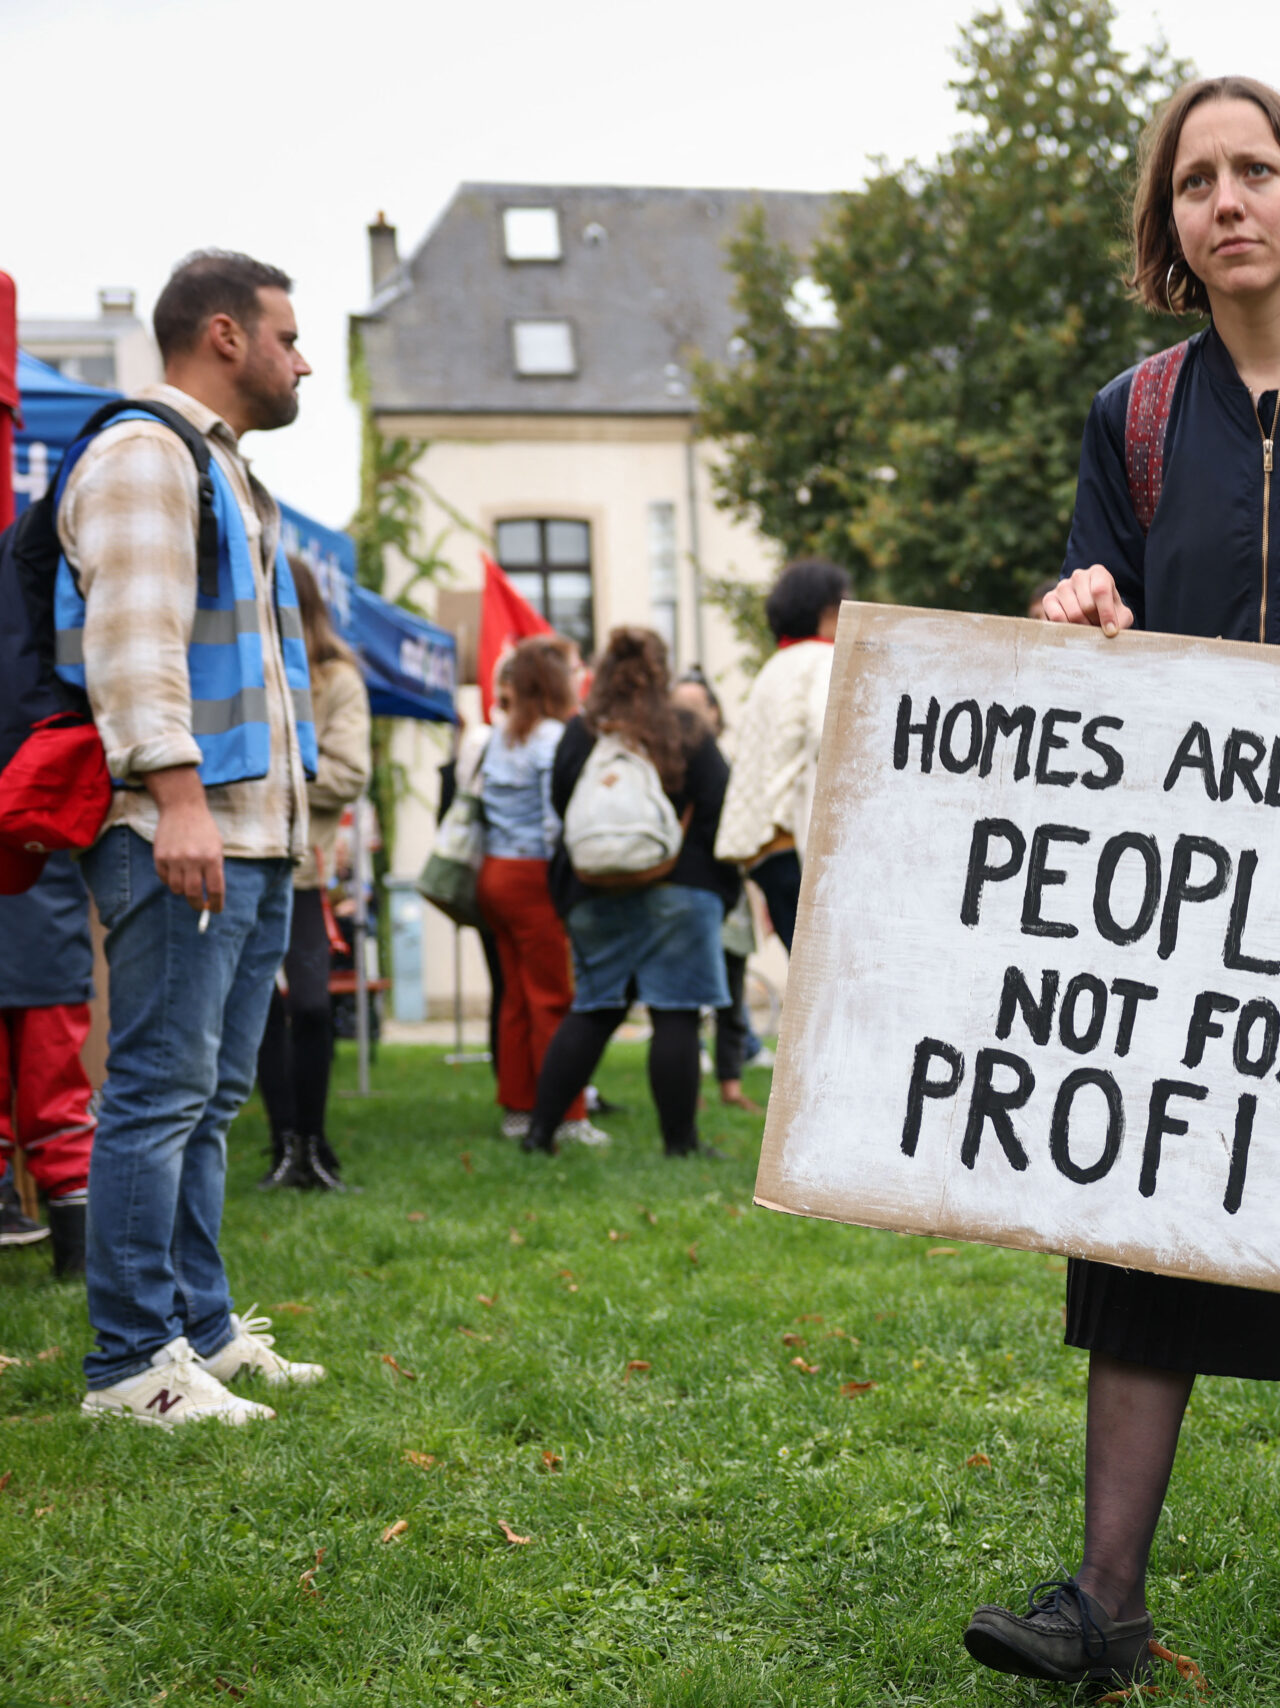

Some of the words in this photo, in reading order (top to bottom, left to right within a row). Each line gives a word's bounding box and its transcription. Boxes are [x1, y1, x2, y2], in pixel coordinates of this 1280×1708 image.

[893, 694, 1125, 790] HOMES
[995, 965, 1159, 1058] NOT
[145, 1388, 183, 1414] N
